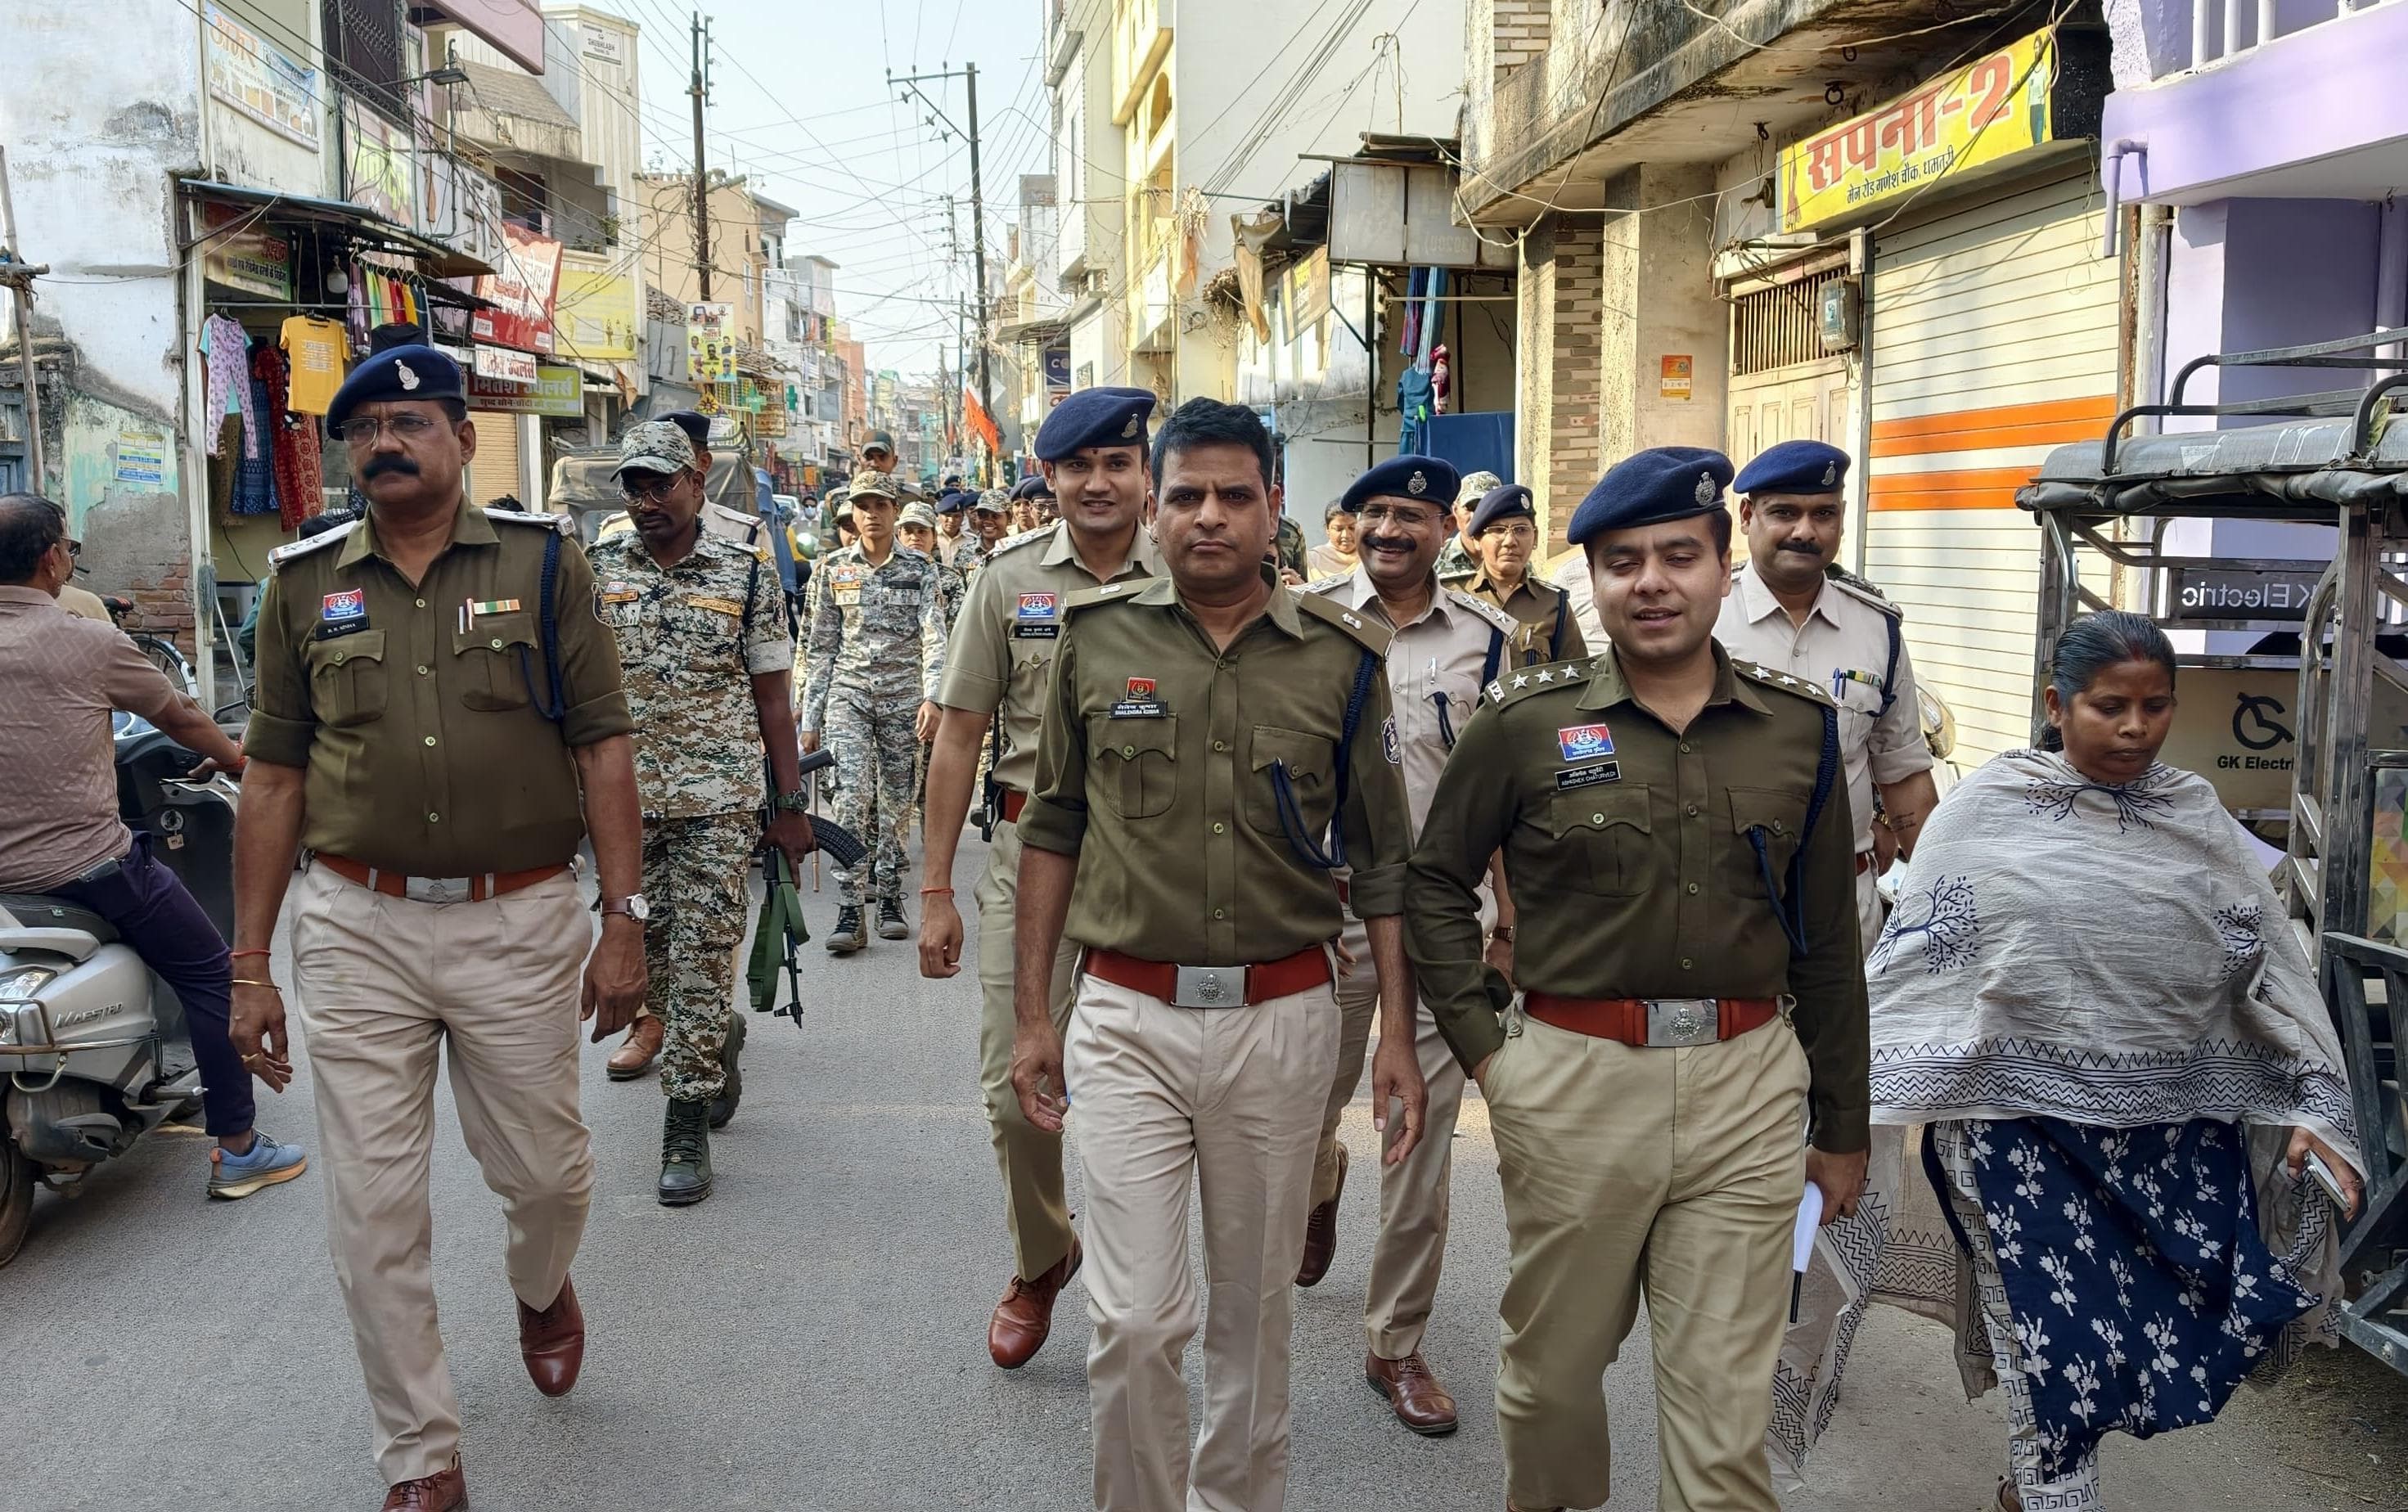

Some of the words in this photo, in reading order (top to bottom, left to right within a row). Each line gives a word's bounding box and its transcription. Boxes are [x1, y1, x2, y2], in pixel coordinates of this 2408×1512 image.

[1807, 54, 2011, 191] सपना-2
[1847, 183, 1861, 203] मेन
[1862, 178, 1875, 197] रोड
[1876, 169, 1899, 193] गणेश
[1924, 145, 1954, 174] धमतरी
[2217, 755, 2240, 769] GK
[54, 1003, 123, 1029] MAESTRO
